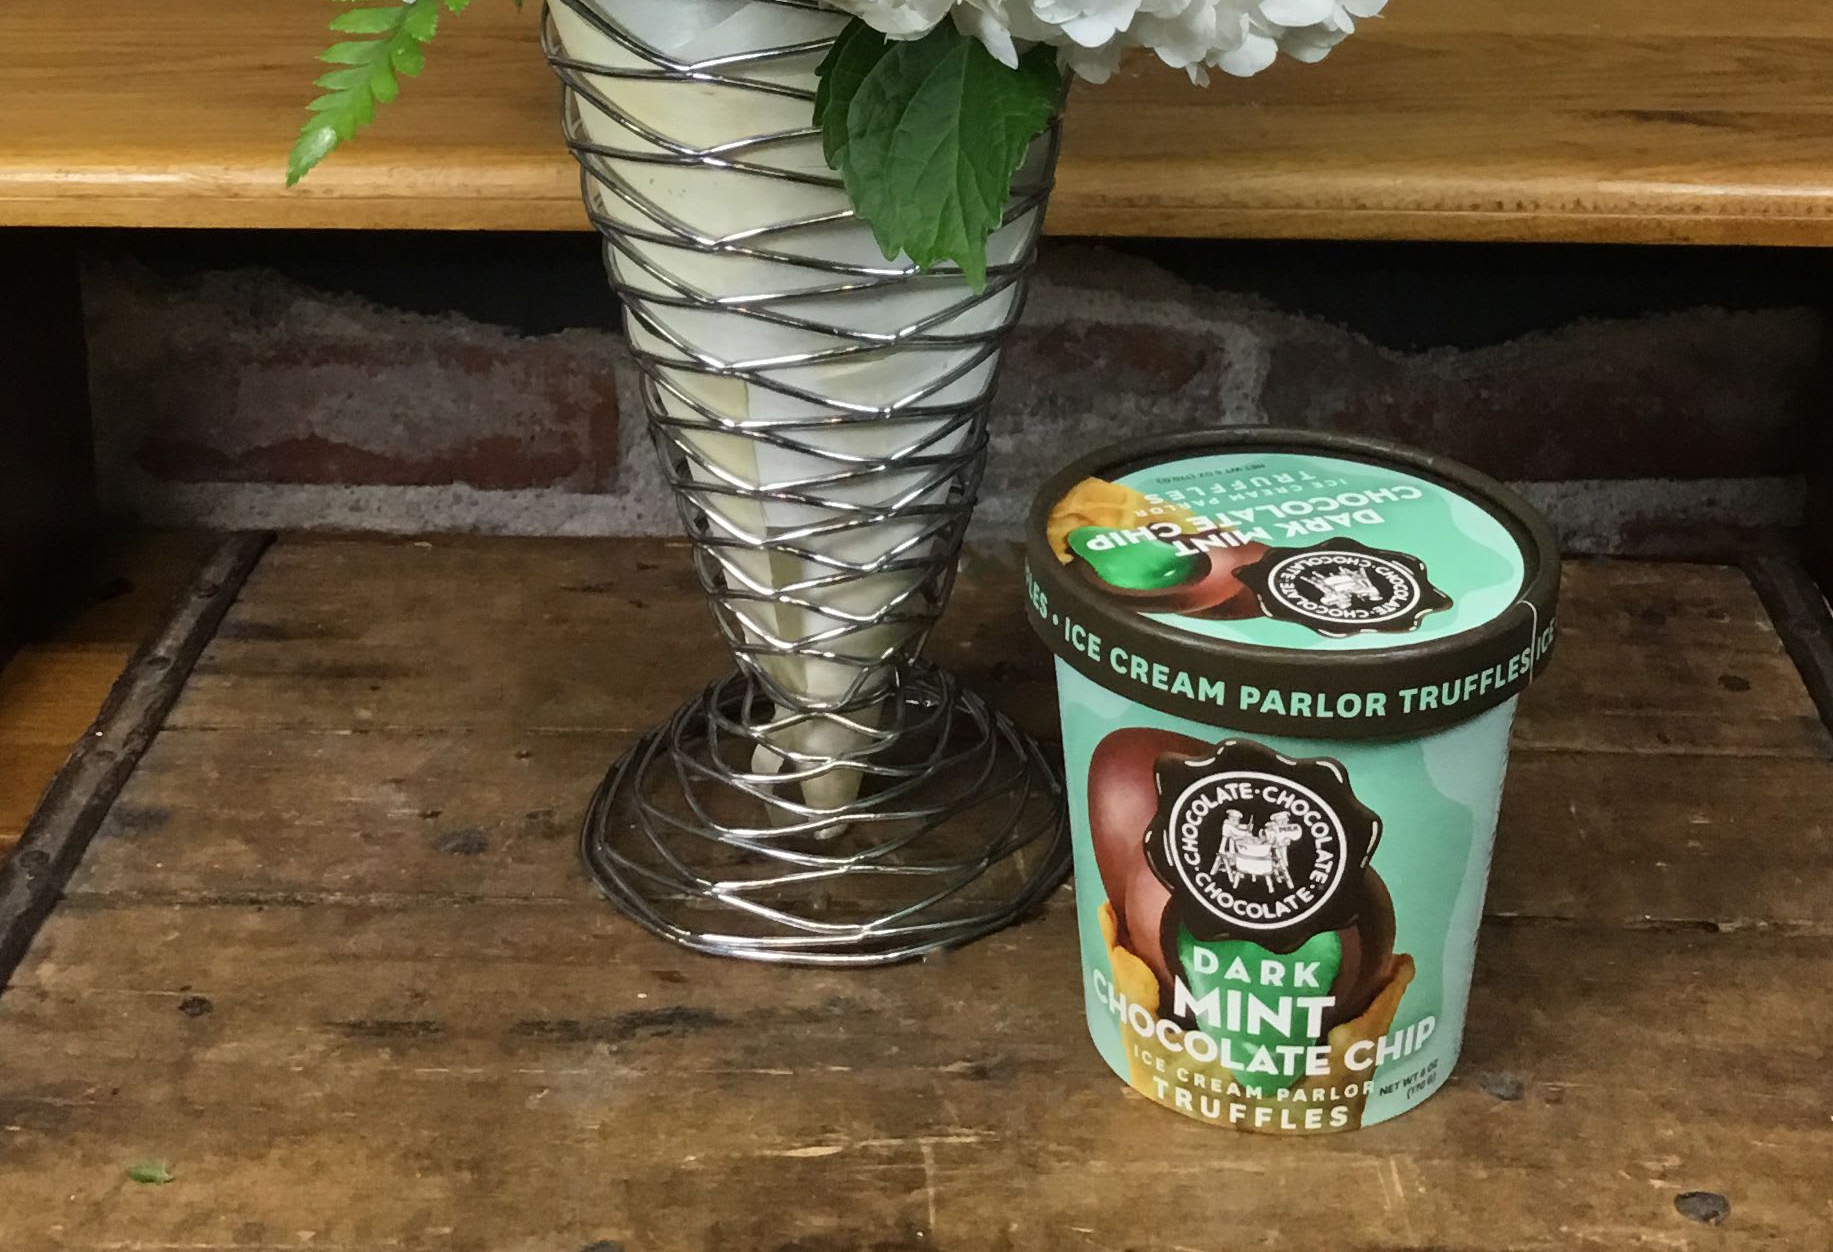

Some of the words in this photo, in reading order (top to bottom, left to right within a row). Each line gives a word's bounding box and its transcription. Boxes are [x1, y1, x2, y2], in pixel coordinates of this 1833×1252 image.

[1143, 470, 1317, 504] TRUFFLES
[1228, 484, 1303, 501] CREAM
[1316, 478, 1348, 489] ICE
[1134, 497, 1220, 517] PARLOR
[1185, 485, 1423, 532] CHOCOLATE
[1274, 508, 1385, 538] DARK
[1087, 522, 1182, 551] CHIP
[1173, 526, 1274, 557] MINT
[1280, 556, 1372, 580] CHOCOLATE
[1279, 582, 1369, 619] CHOCOLATE
[1373, 566, 1410, 616] CHOCOLATE
[1064, 616, 1101, 662] ICE
[1110, 647, 1226, 706] CREAM
[1239, 686, 1387, 718] PARLOR
[1399, 647, 1531, 714] TRUFFLES
[1181, 782, 1254, 866] CHOCOLATE
[1262, 785, 1334, 884] CHOCOLATE
[1195, 872, 1315, 919] CHOCOLATE
[1193, 945, 1321, 988] DARK
[1093, 968, 1332, 1076] CHOCOLATE
[1343, 1015, 1436, 1072] CHIP
[1174, 974, 1336, 1038] MINT
[1133, 1044, 1166, 1073] ICE
[1176, 1068, 1262, 1100] CREAM
[1276, 1080, 1375, 1102] PARLOR
[1379, 1081, 1400, 1096] NET
[1403, 1072, 1418, 1087] WT
[1153, 1076, 1349, 1130] TRUFFLES
